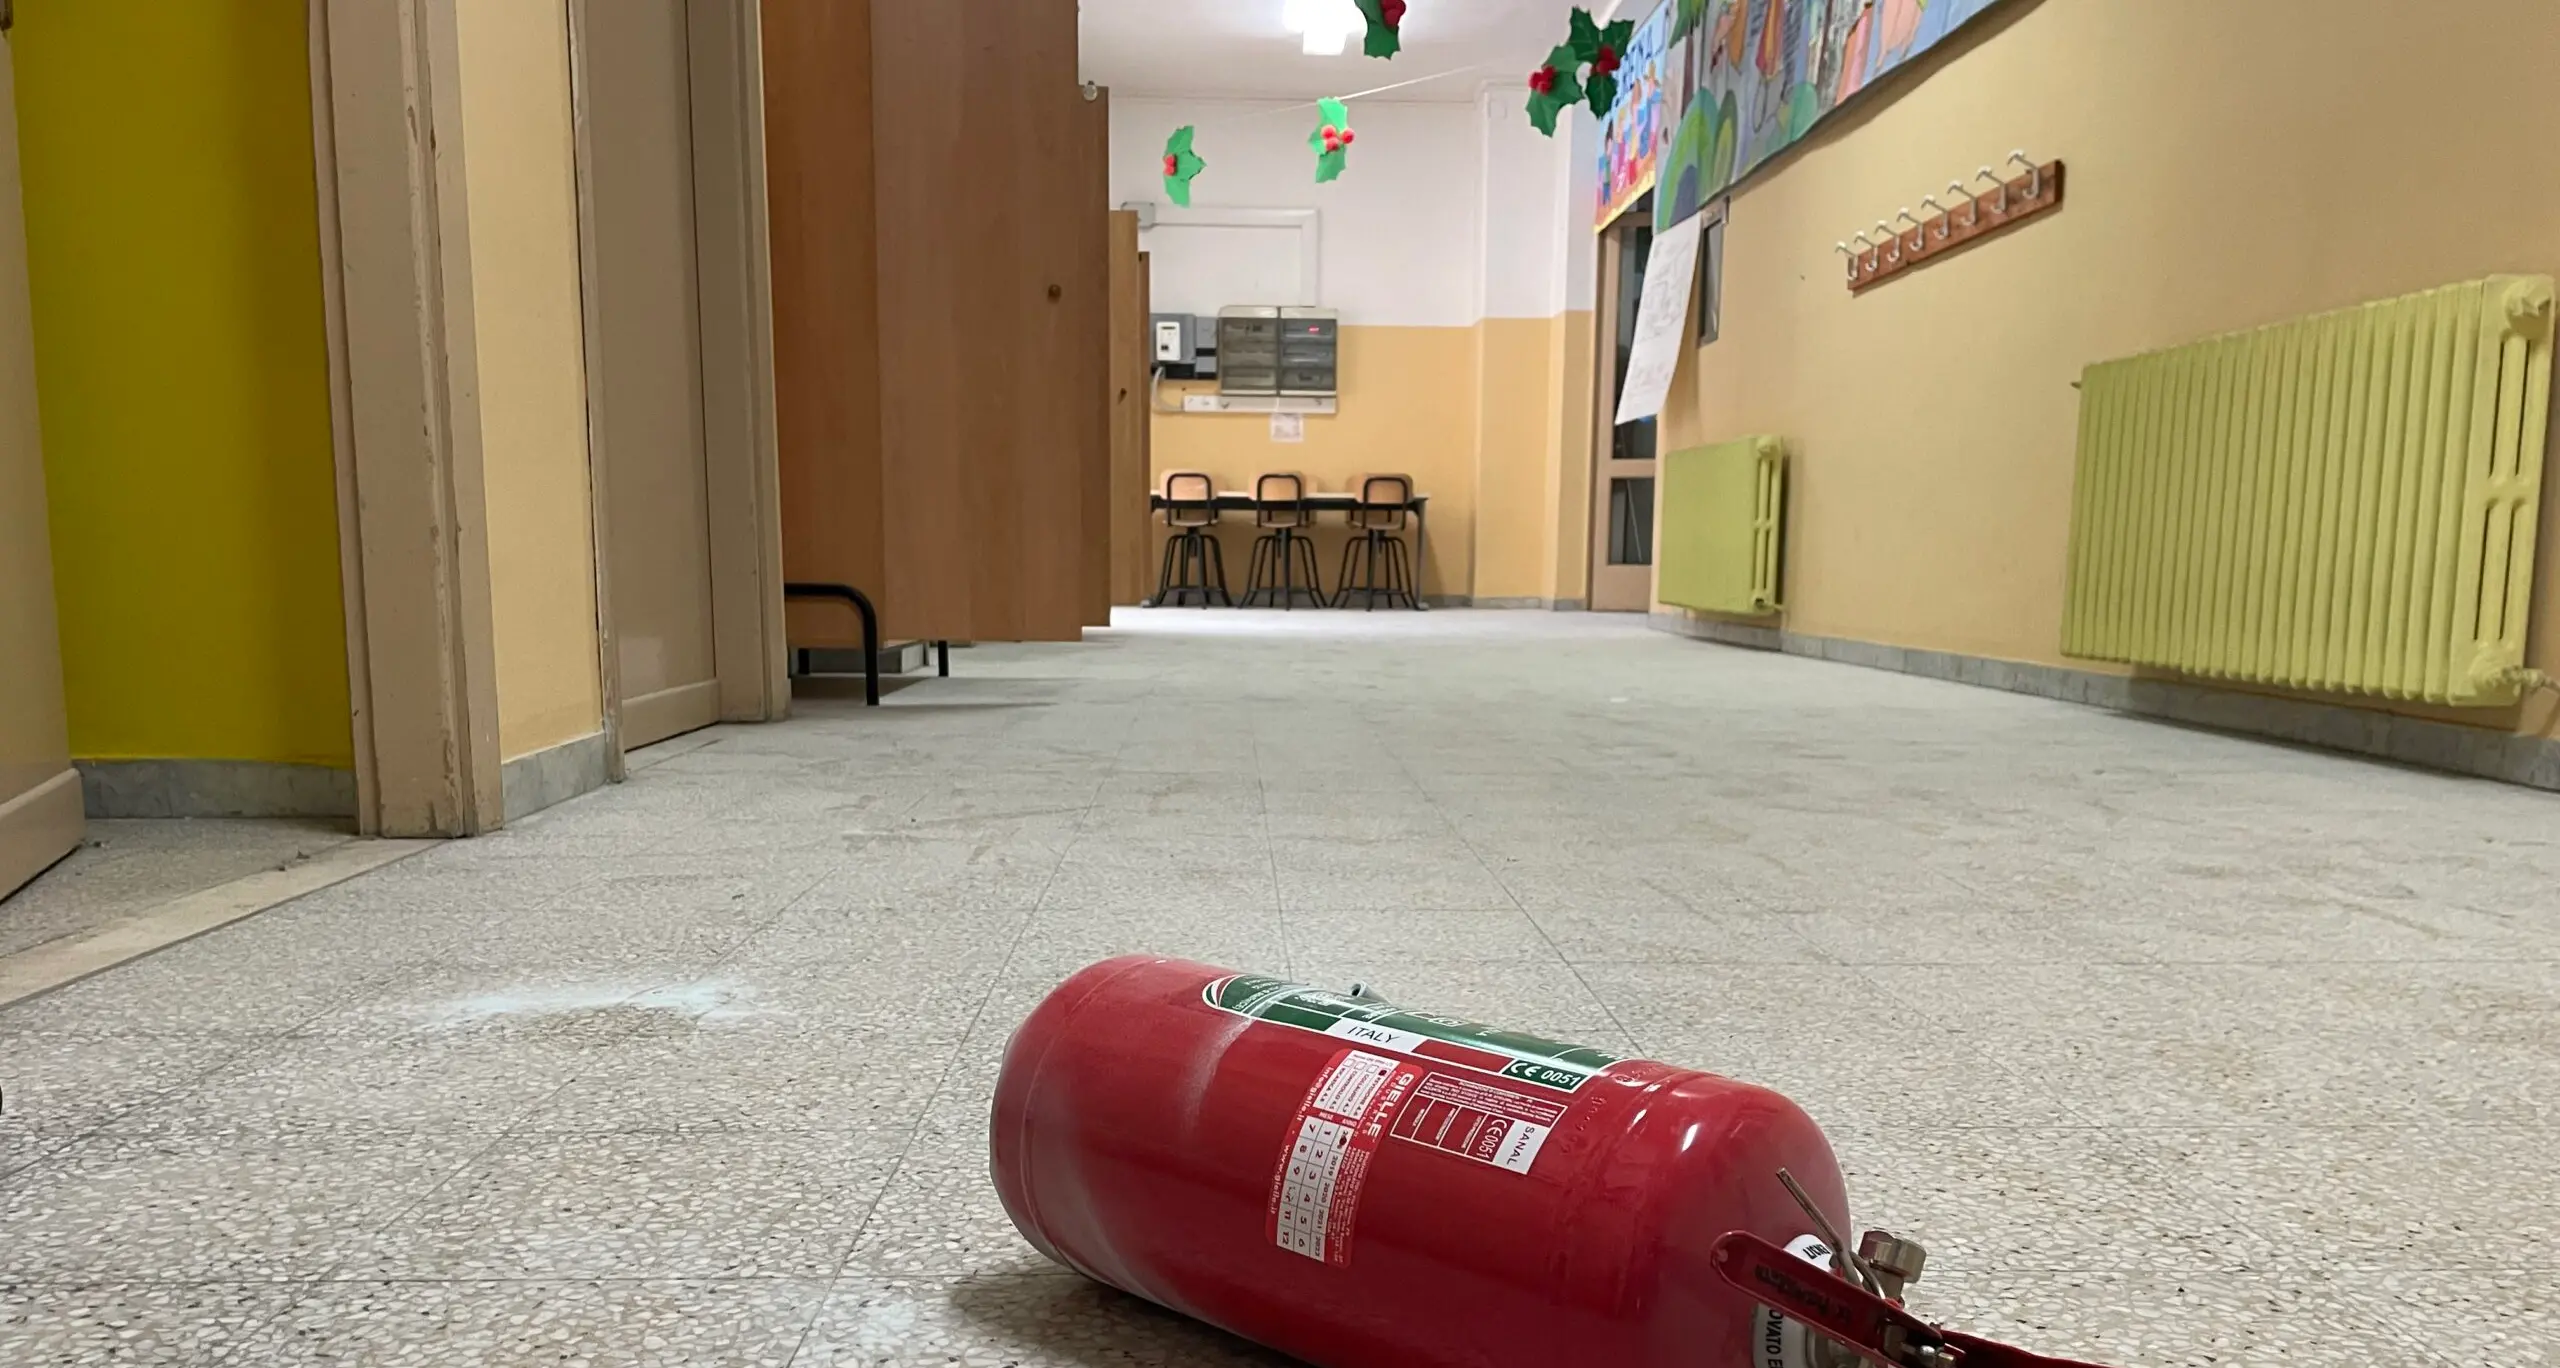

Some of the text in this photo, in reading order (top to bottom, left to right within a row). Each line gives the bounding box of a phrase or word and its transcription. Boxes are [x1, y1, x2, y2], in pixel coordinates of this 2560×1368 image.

[1347, 1026, 1401, 1044] ITALY
[1540, 1068, 1582, 1087] 0051
[1366, 1072, 1414, 1139] GIELLE
[1308, 1124, 1316, 1133] 7
[1299, 1144, 1308, 1154] 8
[1506, 1126, 1534, 1165] SANAL
[1315, 1149, 1323, 1159] 2
[1292, 1166, 1301, 1175] 9
[1328, 1156, 1338, 1176] 2019
[1308, 1170, 1316, 1180] 3
[1321, 1182, 1330, 1203] 2020
[1304, 1194, 1311, 1203] 4
[1284, 1210, 1292, 1220] 11
[1300, 1216, 1308, 1224] 5
[1316, 1209, 1325, 1230] 2021
[1281, 1231, 1290, 1245] 12
[1298, 1238, 1306, 1248] 6
